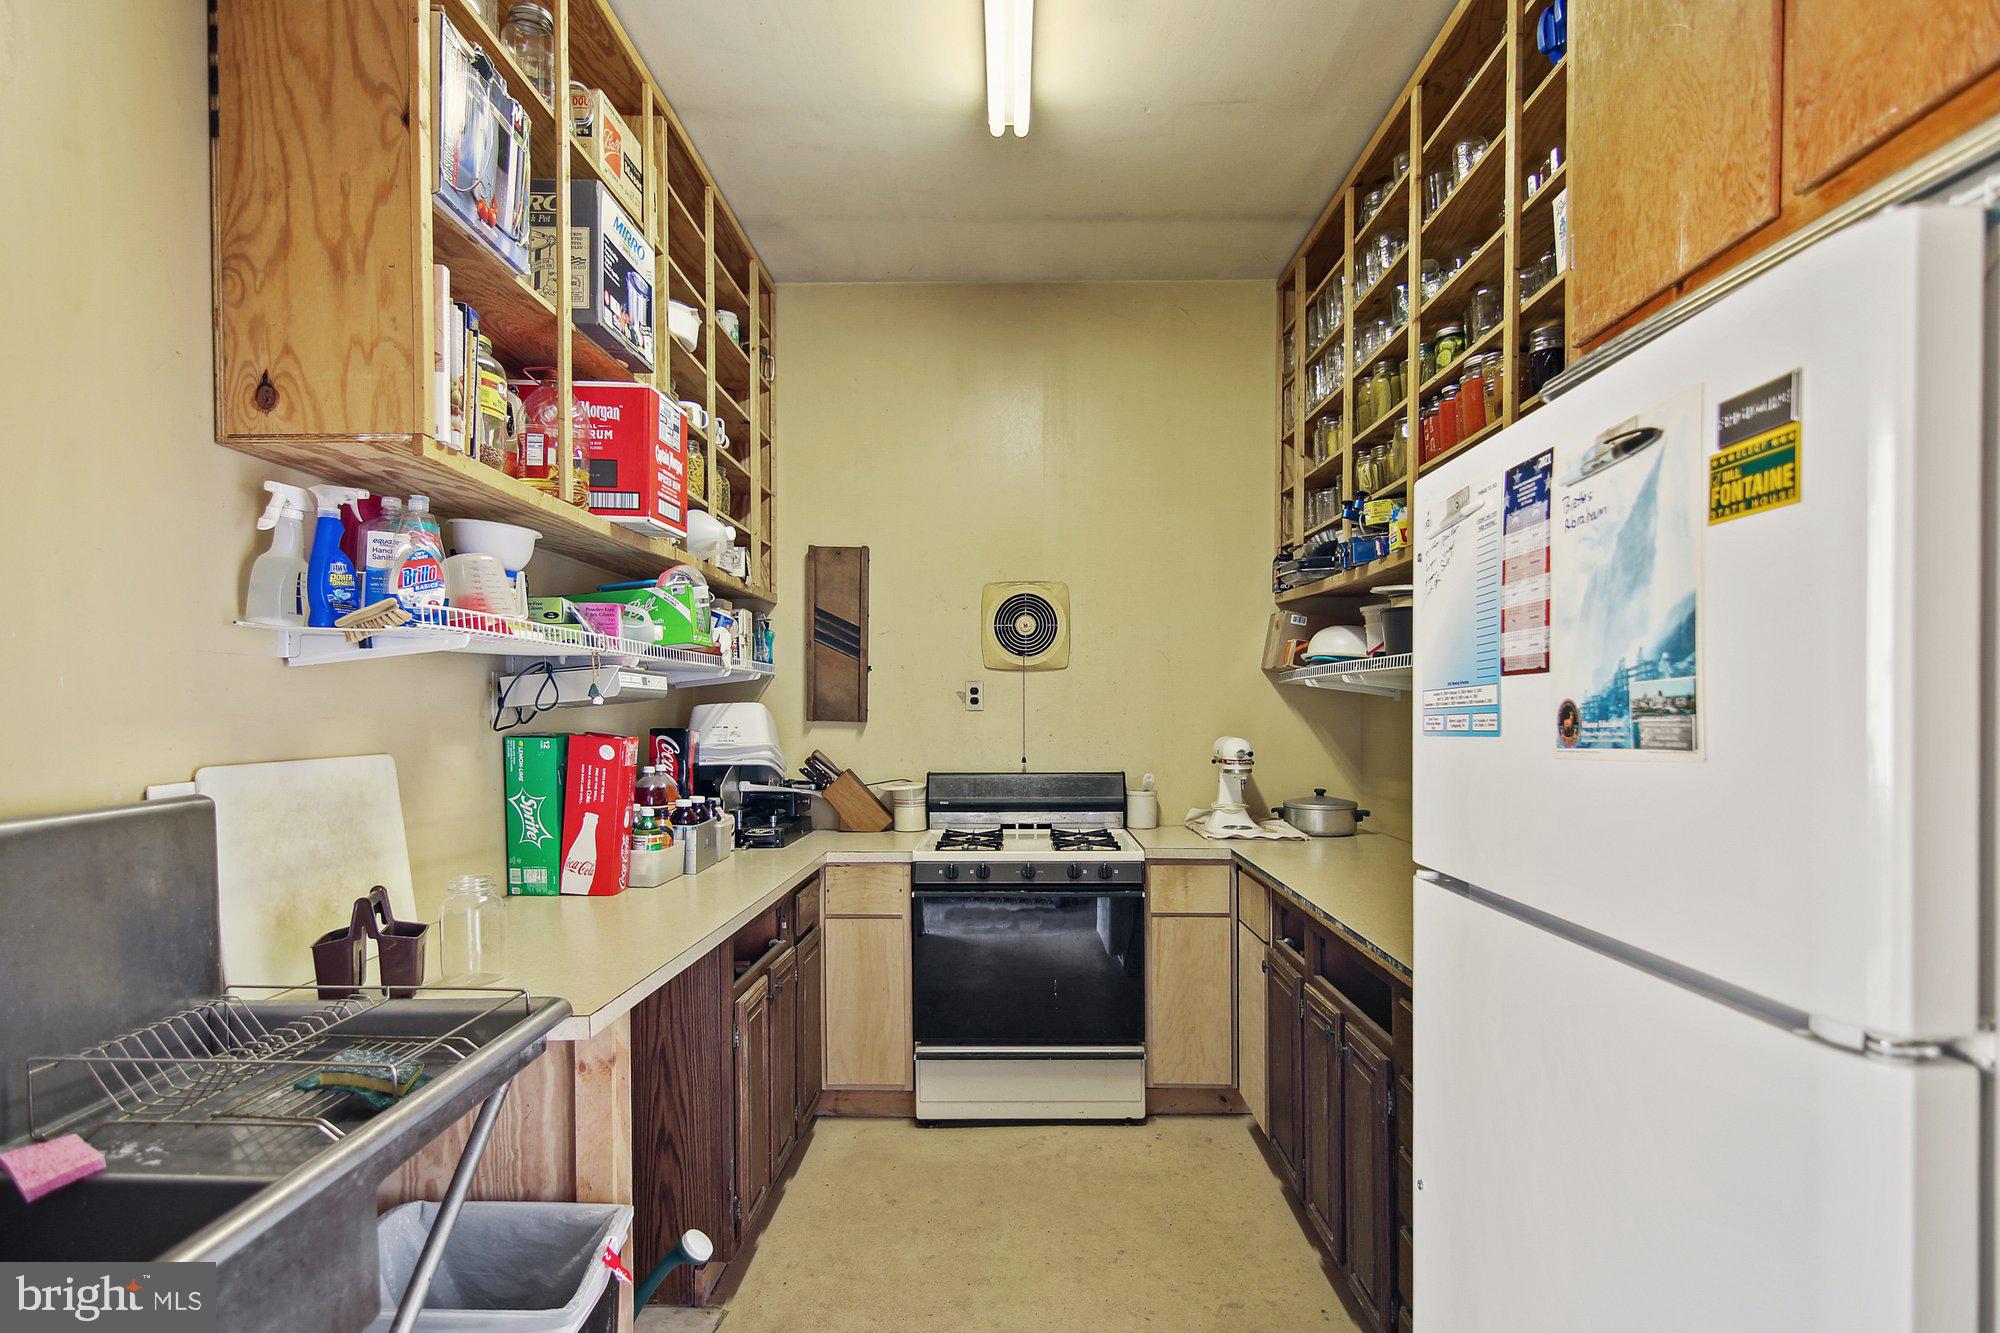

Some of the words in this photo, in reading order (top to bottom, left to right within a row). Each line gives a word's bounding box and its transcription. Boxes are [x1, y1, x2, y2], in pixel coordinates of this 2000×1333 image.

[538, 215, 551, 223] Pot
[613, 215, 646, 262] MIRRO
[579, 401, 620, 421] Morgan
[590, 430, 613, 439] RUM
[1711, 463, 1795, 508] FONTAINE
[1751, 489, 1795, 510] HOUSE
[402, 565, 438, 587] Brillo
[415, 583, 439, 592] BASICS
[543, 740, 550, 749] 12
[520, 795, 541, 841] Sprite
